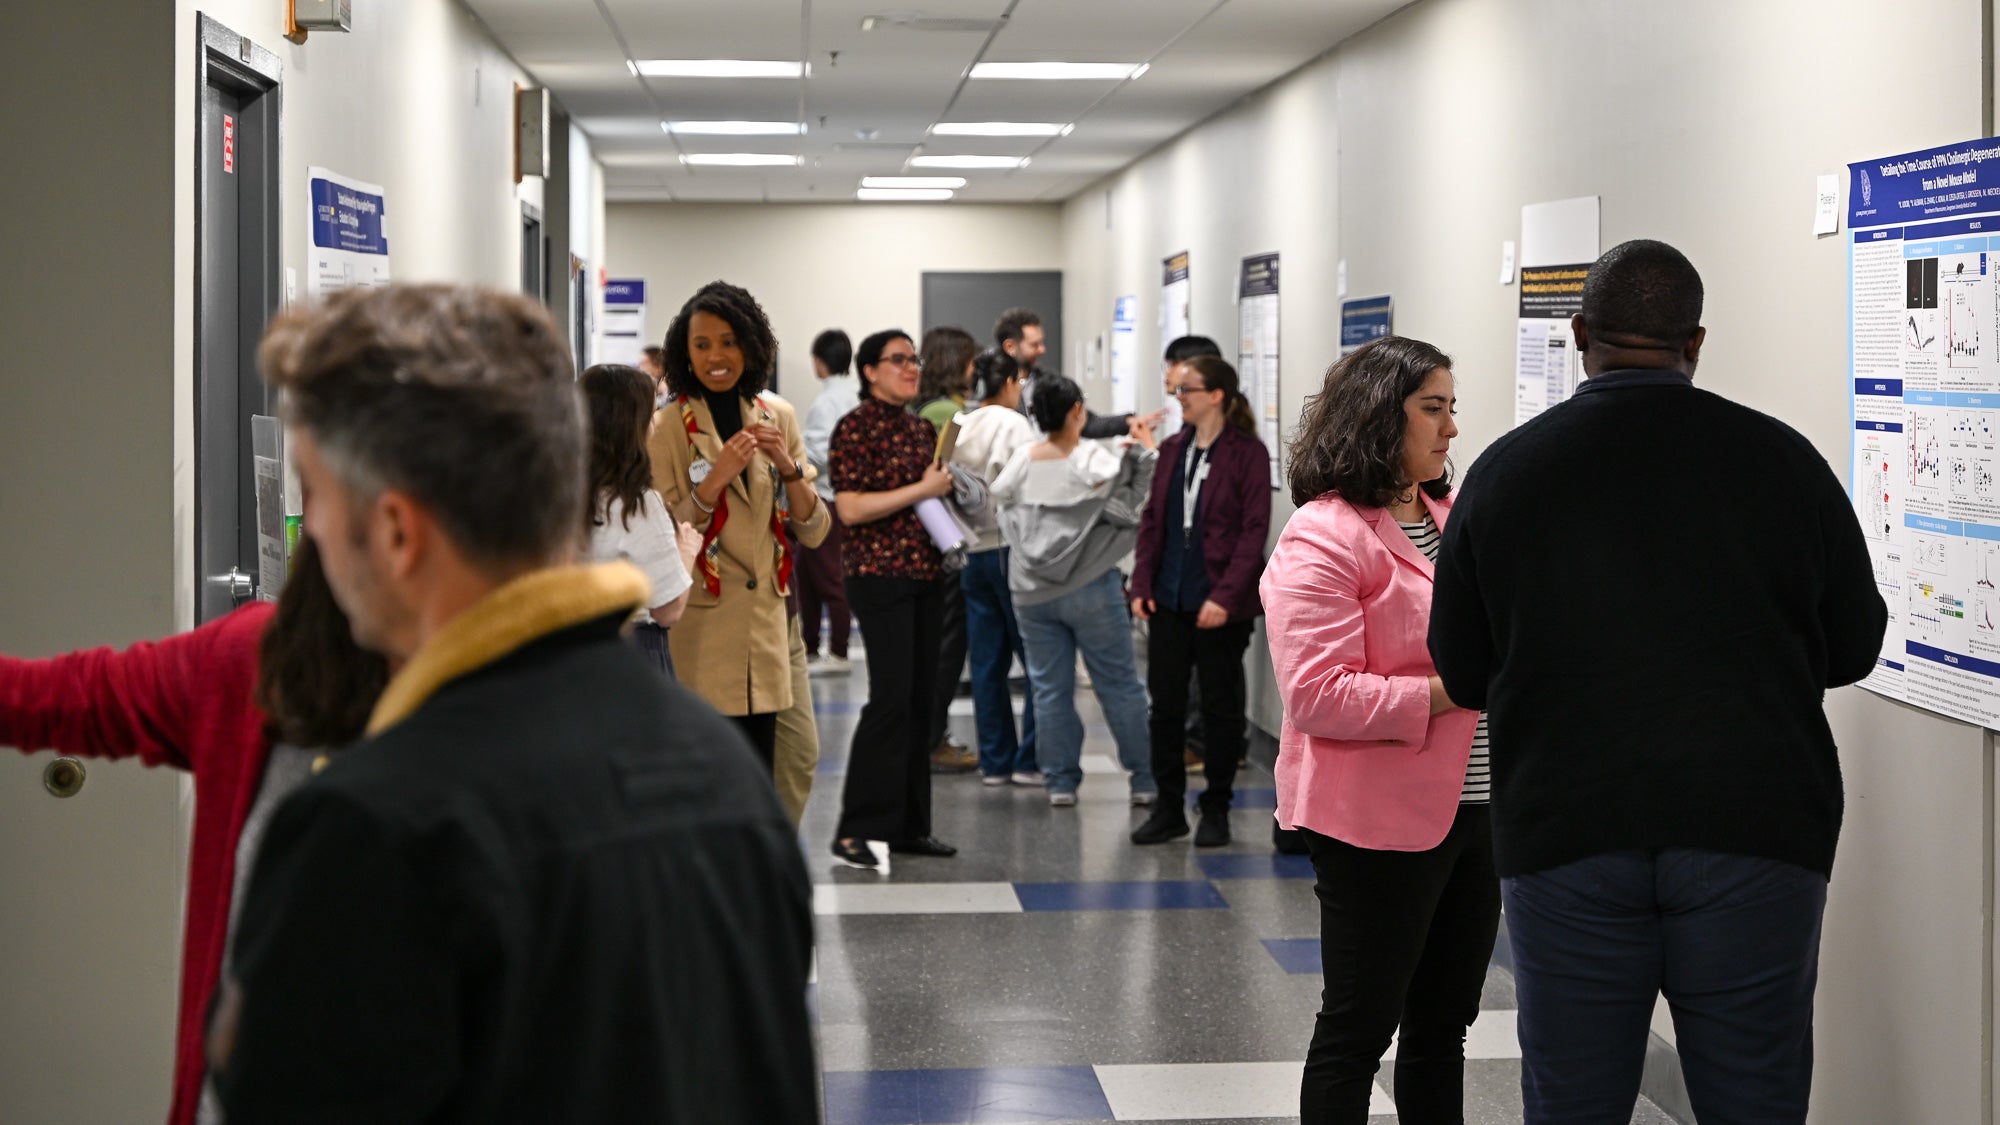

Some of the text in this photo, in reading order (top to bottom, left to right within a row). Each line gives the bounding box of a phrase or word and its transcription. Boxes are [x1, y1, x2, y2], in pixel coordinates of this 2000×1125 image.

[1880, 163, 1900, 177] Detailing
[1898, 161, 1907, 174] the
[1904, 160, 1917, 172] Time
[1916, 158, 1932, 171] Course
[1931, 155, 1938, 169] of
[1936, 154, 1948, 167] PPN
[1946, 149, 1971, 165] Cholinergic
[1922, 169, 1977, 191] from a Novel Mouse Model
